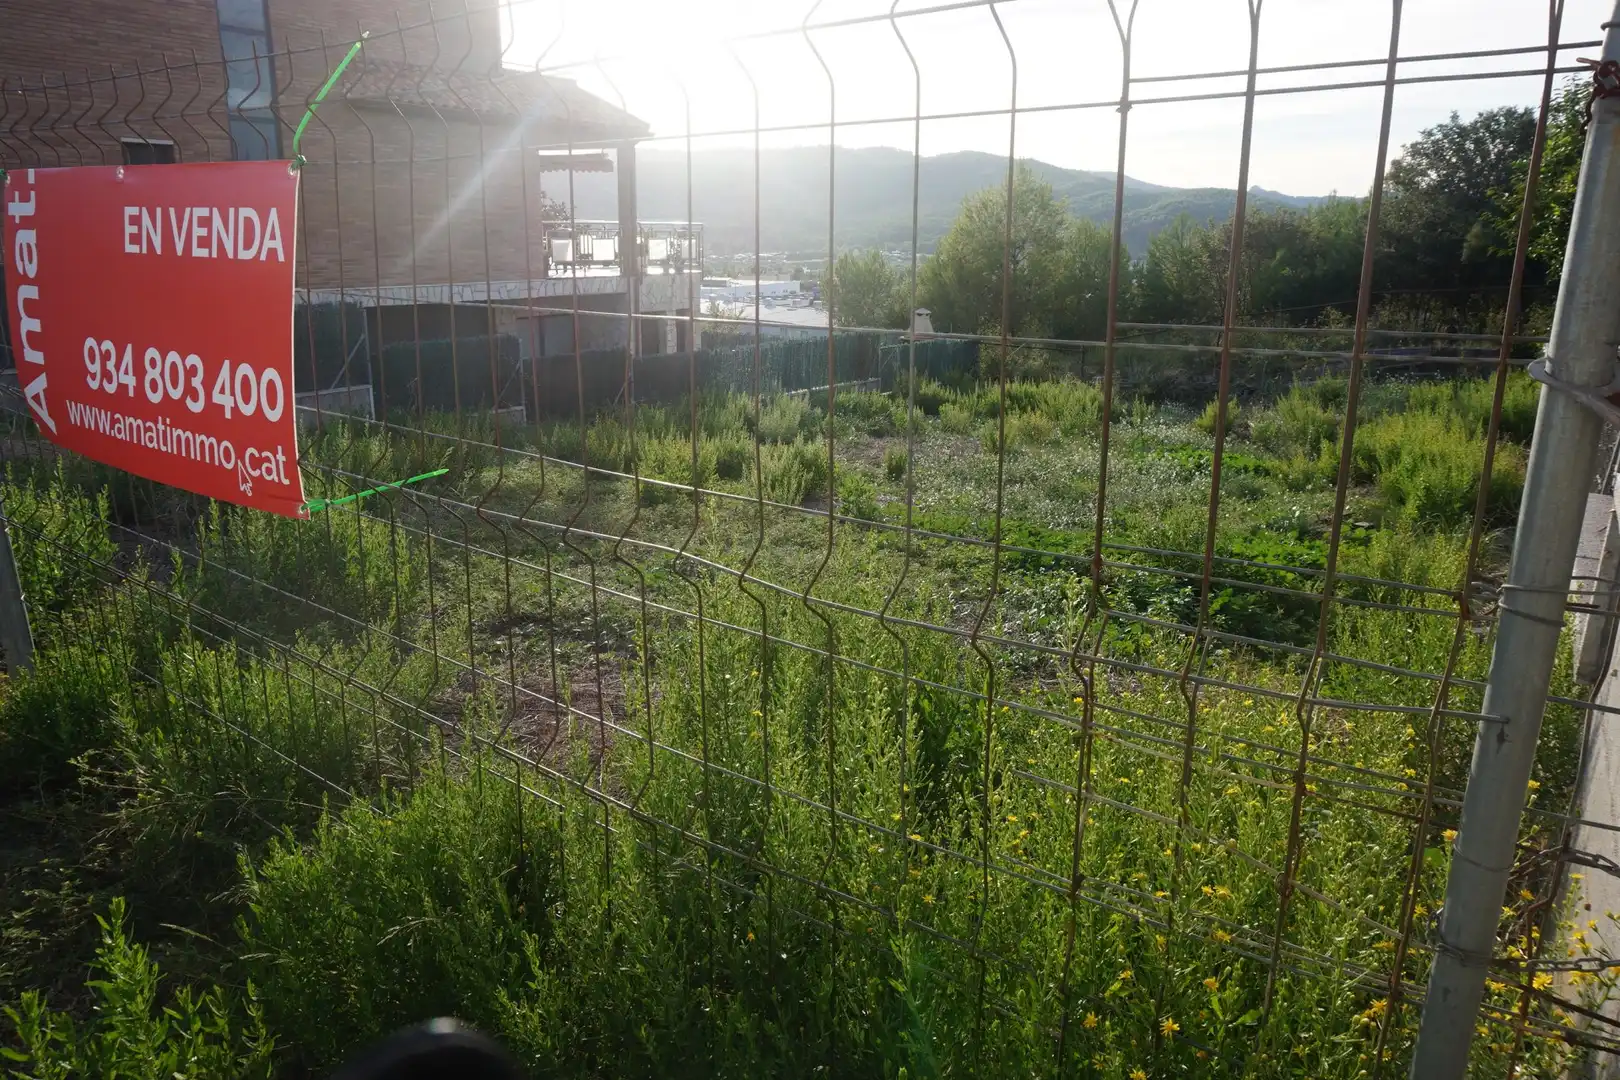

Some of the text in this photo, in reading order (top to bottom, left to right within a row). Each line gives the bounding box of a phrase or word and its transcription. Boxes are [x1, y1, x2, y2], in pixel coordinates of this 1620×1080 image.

[124, 206, 285, 262] EN VENDA
[83, 336, 285, 423] 934 803 400
[66, 399, 290, 486] www.amatimmocat
